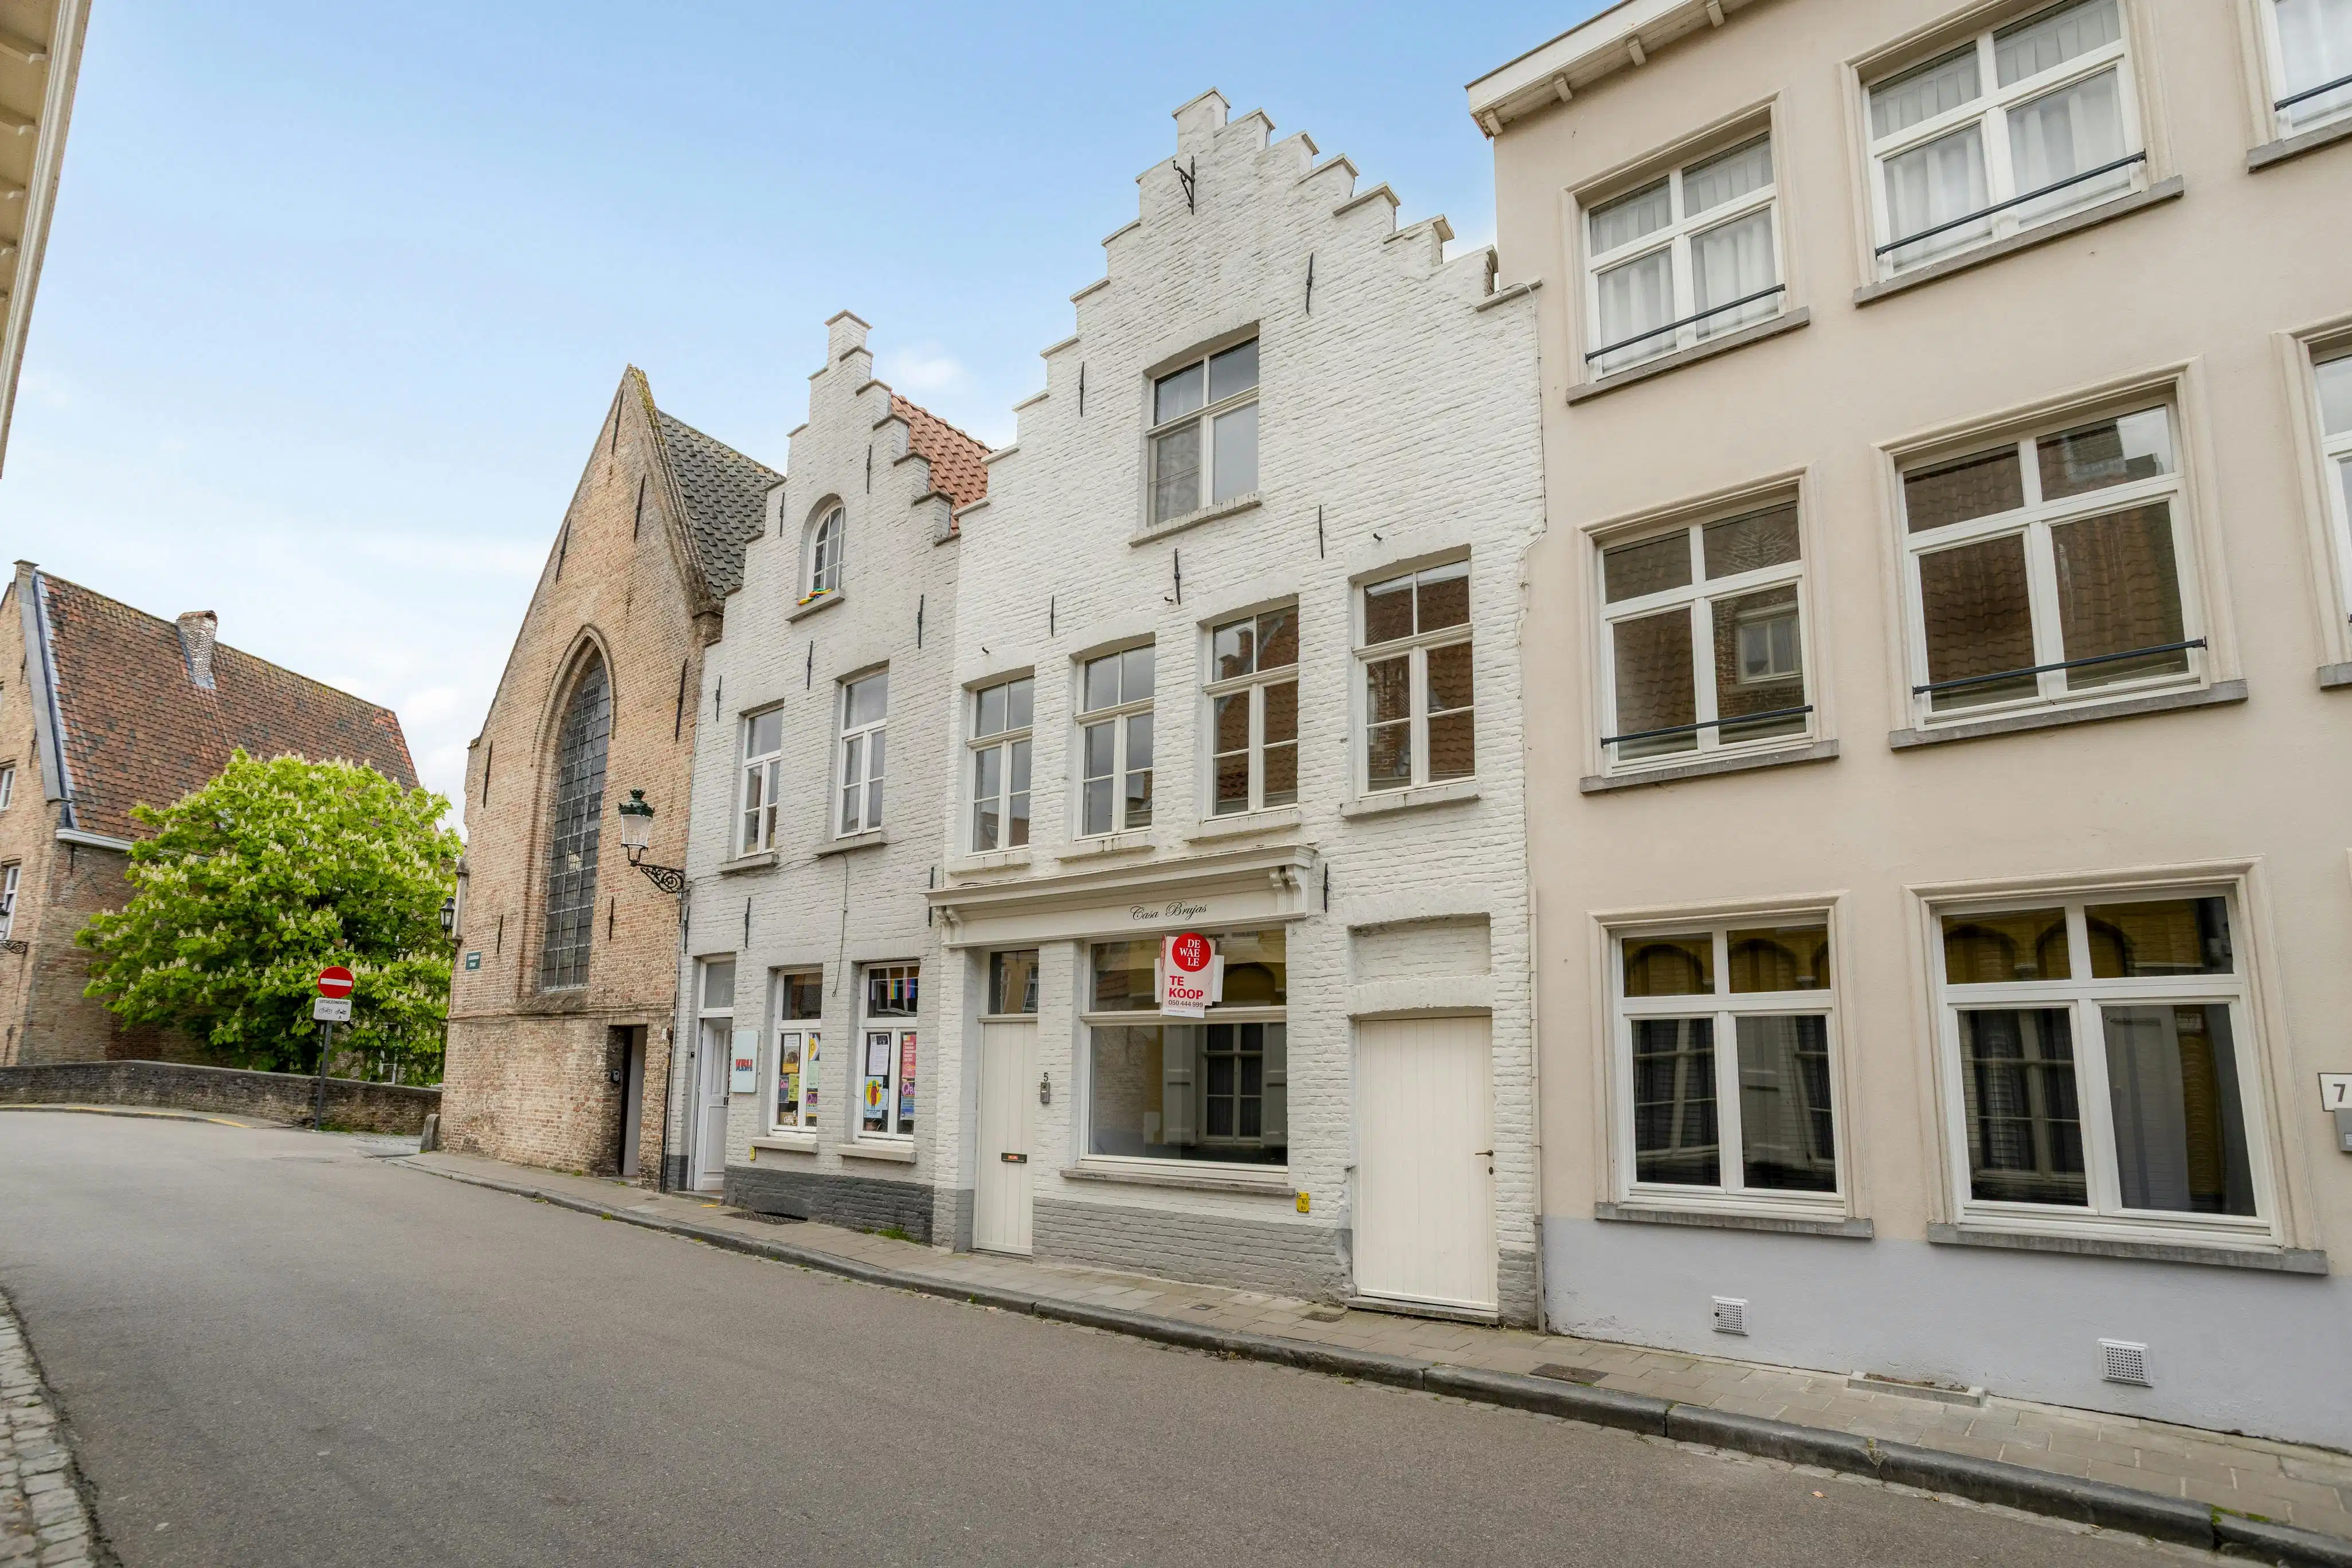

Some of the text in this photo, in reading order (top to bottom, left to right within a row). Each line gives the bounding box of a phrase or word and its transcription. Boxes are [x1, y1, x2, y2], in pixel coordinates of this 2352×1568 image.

[1130, 901, 1208, 920] Casa Brujas
[1187, 939, 1201, 948] DE
[1179, 947, 1200, 958] WAE
[1187, 957, 1199, 966] LE
[1169, 975, 1184, 986] TE
[1169, 987, 1204, 999] KOOP
[1044, 1072, 1049, 1082] 5
[2333, 1083, 2346, 1103] 7
